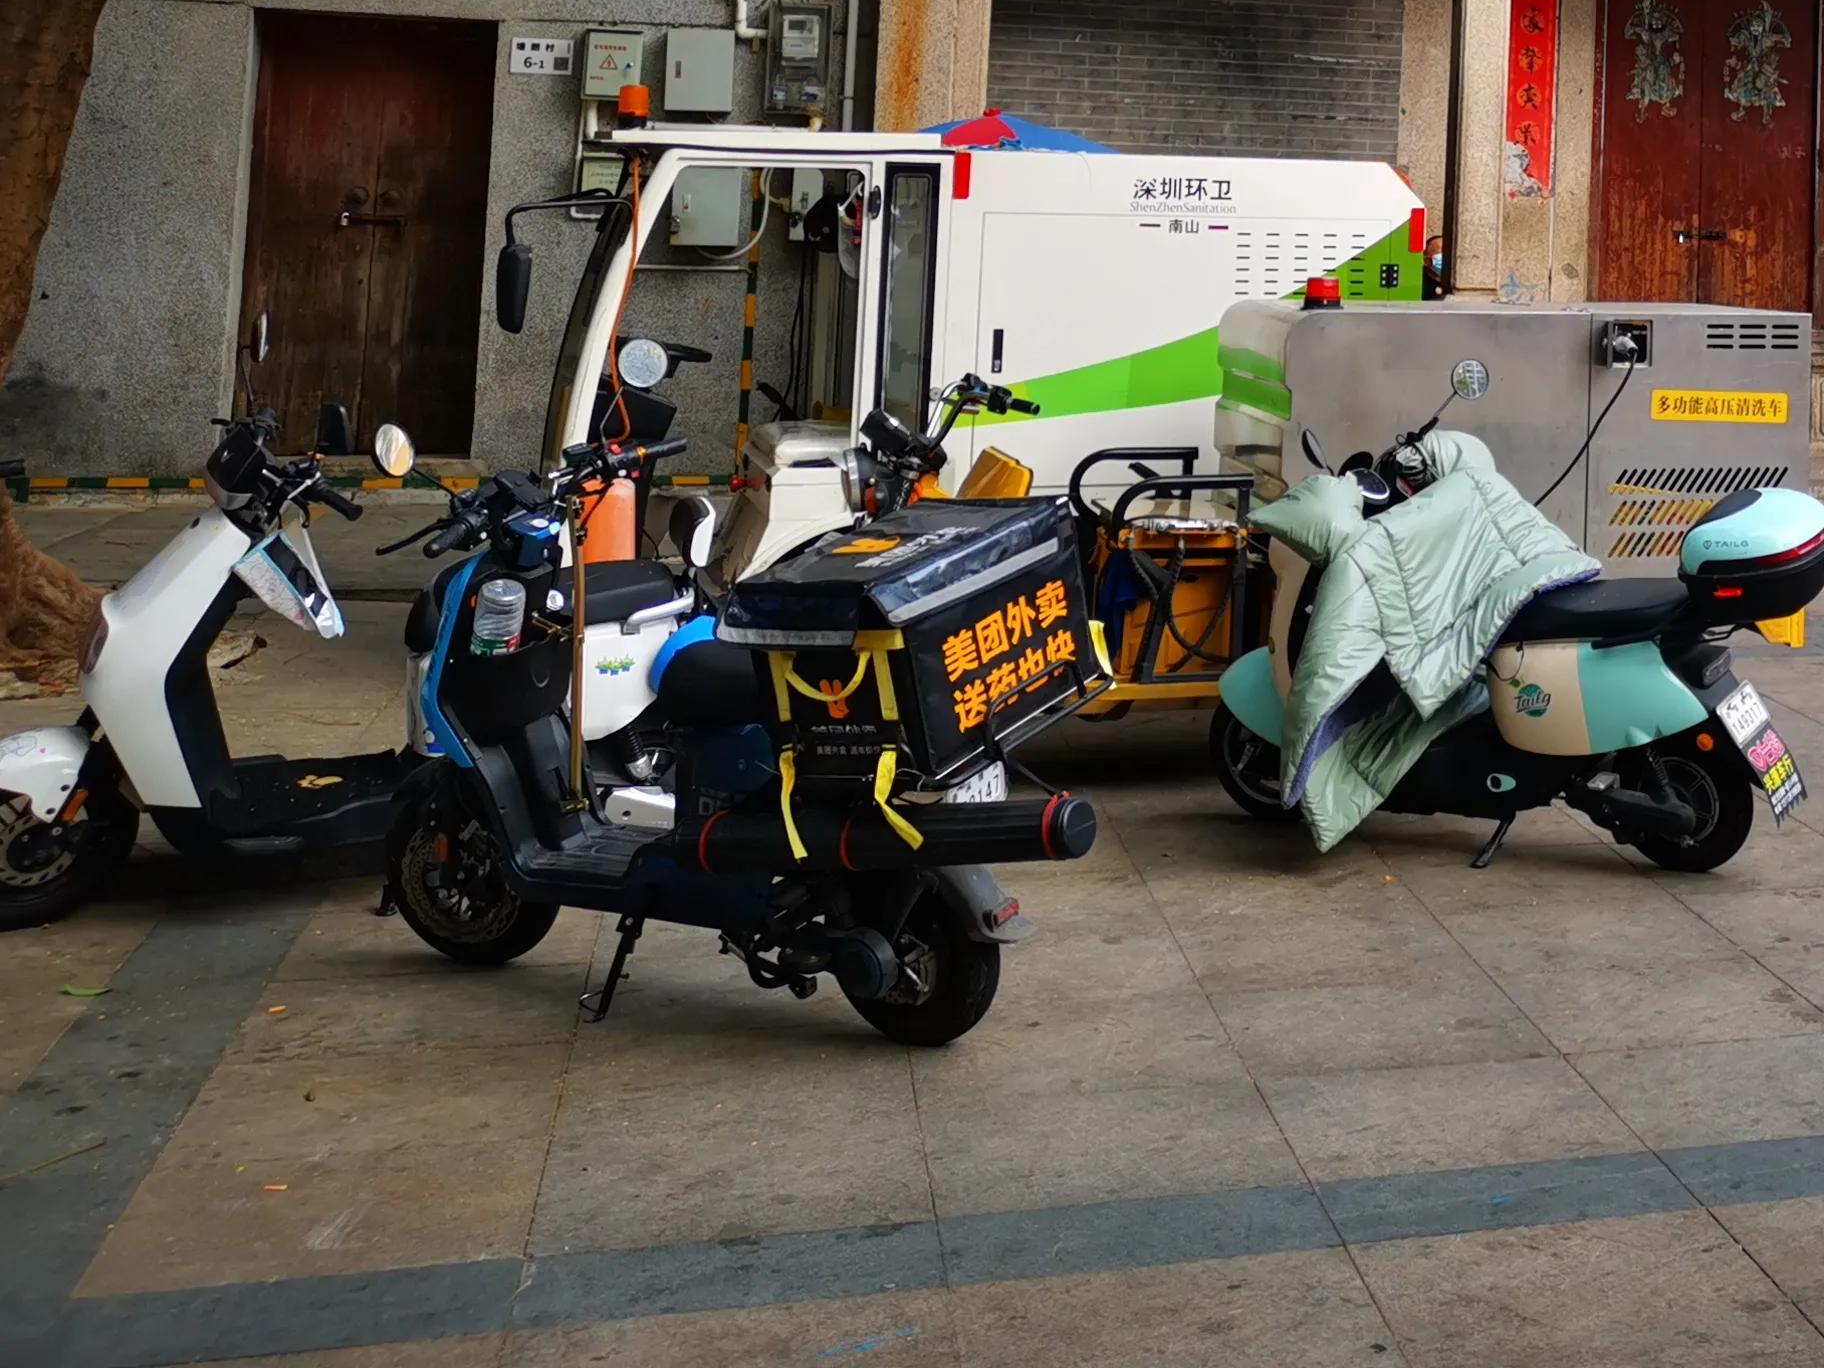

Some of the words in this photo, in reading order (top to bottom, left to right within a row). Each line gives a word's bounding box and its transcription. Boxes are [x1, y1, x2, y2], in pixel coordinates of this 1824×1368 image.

[523, 57, 545, 69] 6-1
[1133, 177, 1232, 200] 深圳环卫
[1129, 201, 1237, 213] ShenZhenSanitation
[1169, 219, 1199, 233] 南山
[1658, 395, 1783, 417] 多功能高压清洗车
[942, 580, 1068, 682] 美团外卖
